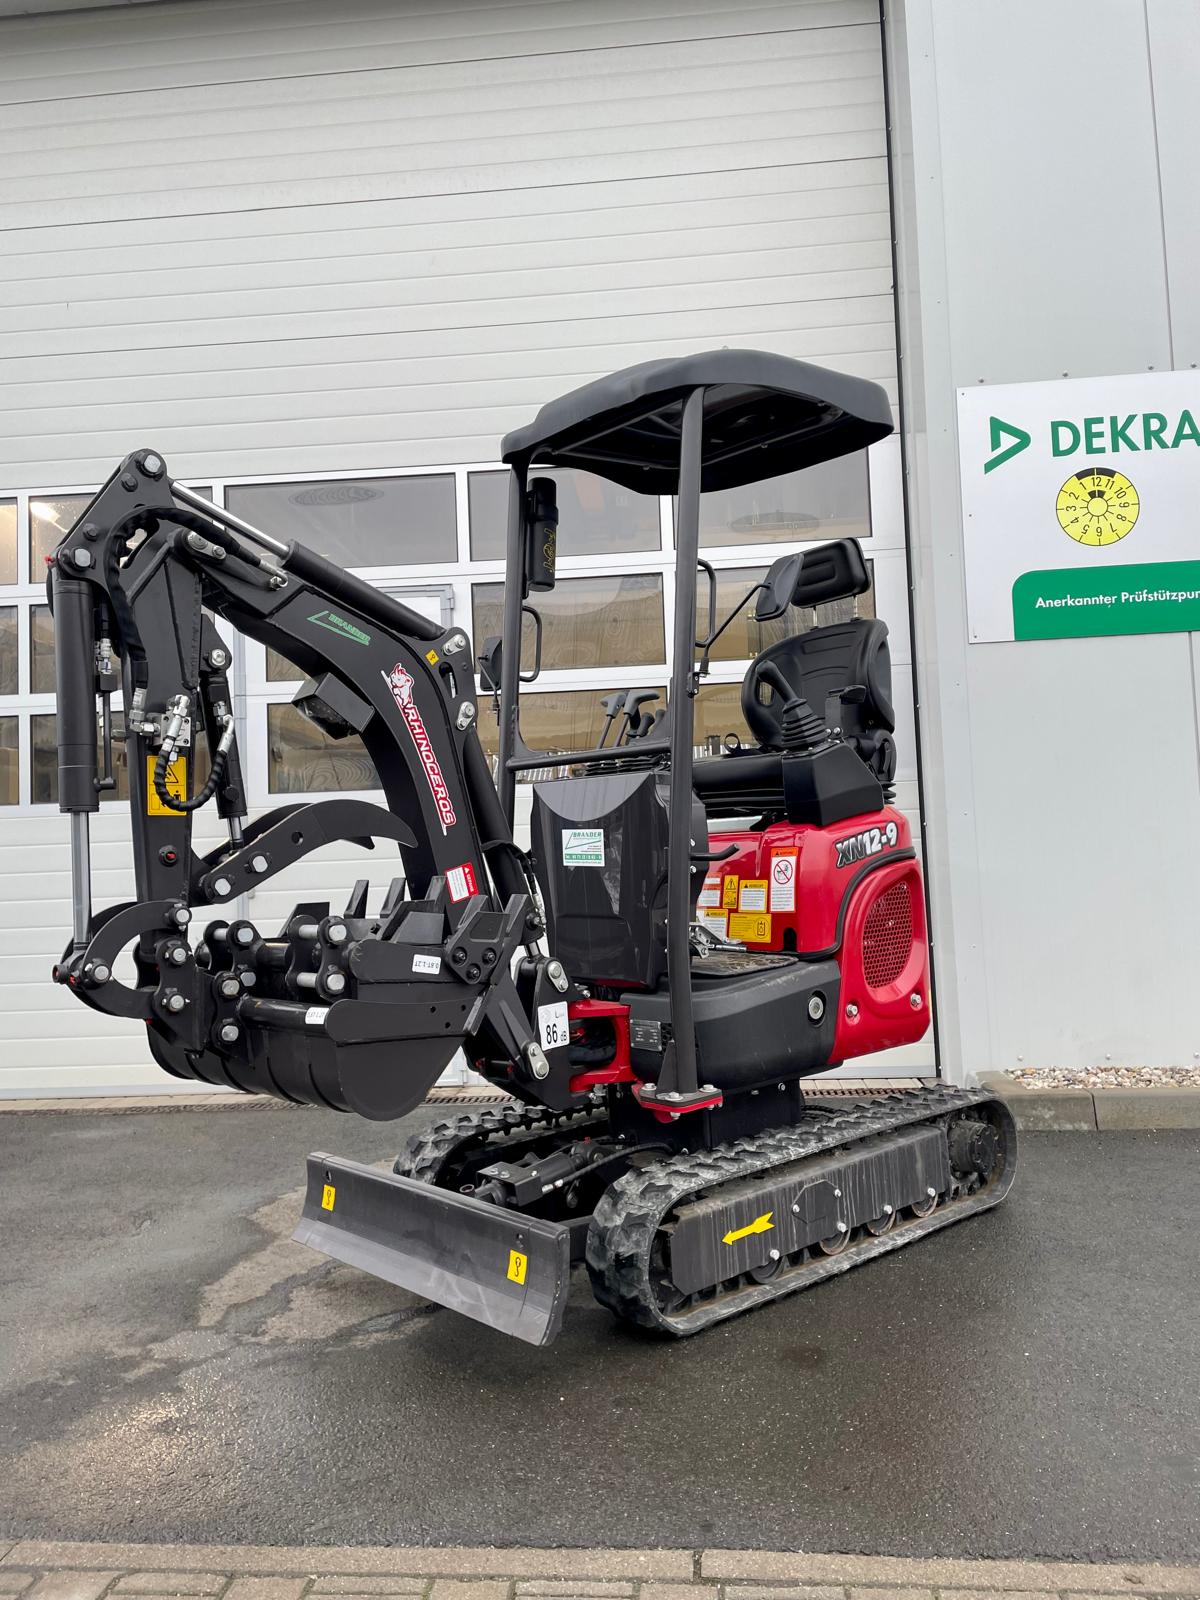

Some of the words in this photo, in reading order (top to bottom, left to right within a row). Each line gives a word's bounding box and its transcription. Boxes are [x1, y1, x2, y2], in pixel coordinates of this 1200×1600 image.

[1050, 409, 1200, 457] DEKRA
[1091, 477, 1102, 487] 12
[1104, 478, 1115, 490] 11
[1068, 491, 1080, 501] 2
[1115, 486, 1127, 499] 10
[1116, 513, 1127, 522] 8
[1035, 595, 1118, 608] Anerkannter
[405, 707, 456, 826] RHINOCEROS
[836, 821, 898, 868] XN12-9
[545, 1022, 558, 1045] 86
[560, 1030, 568, 1042] dB
